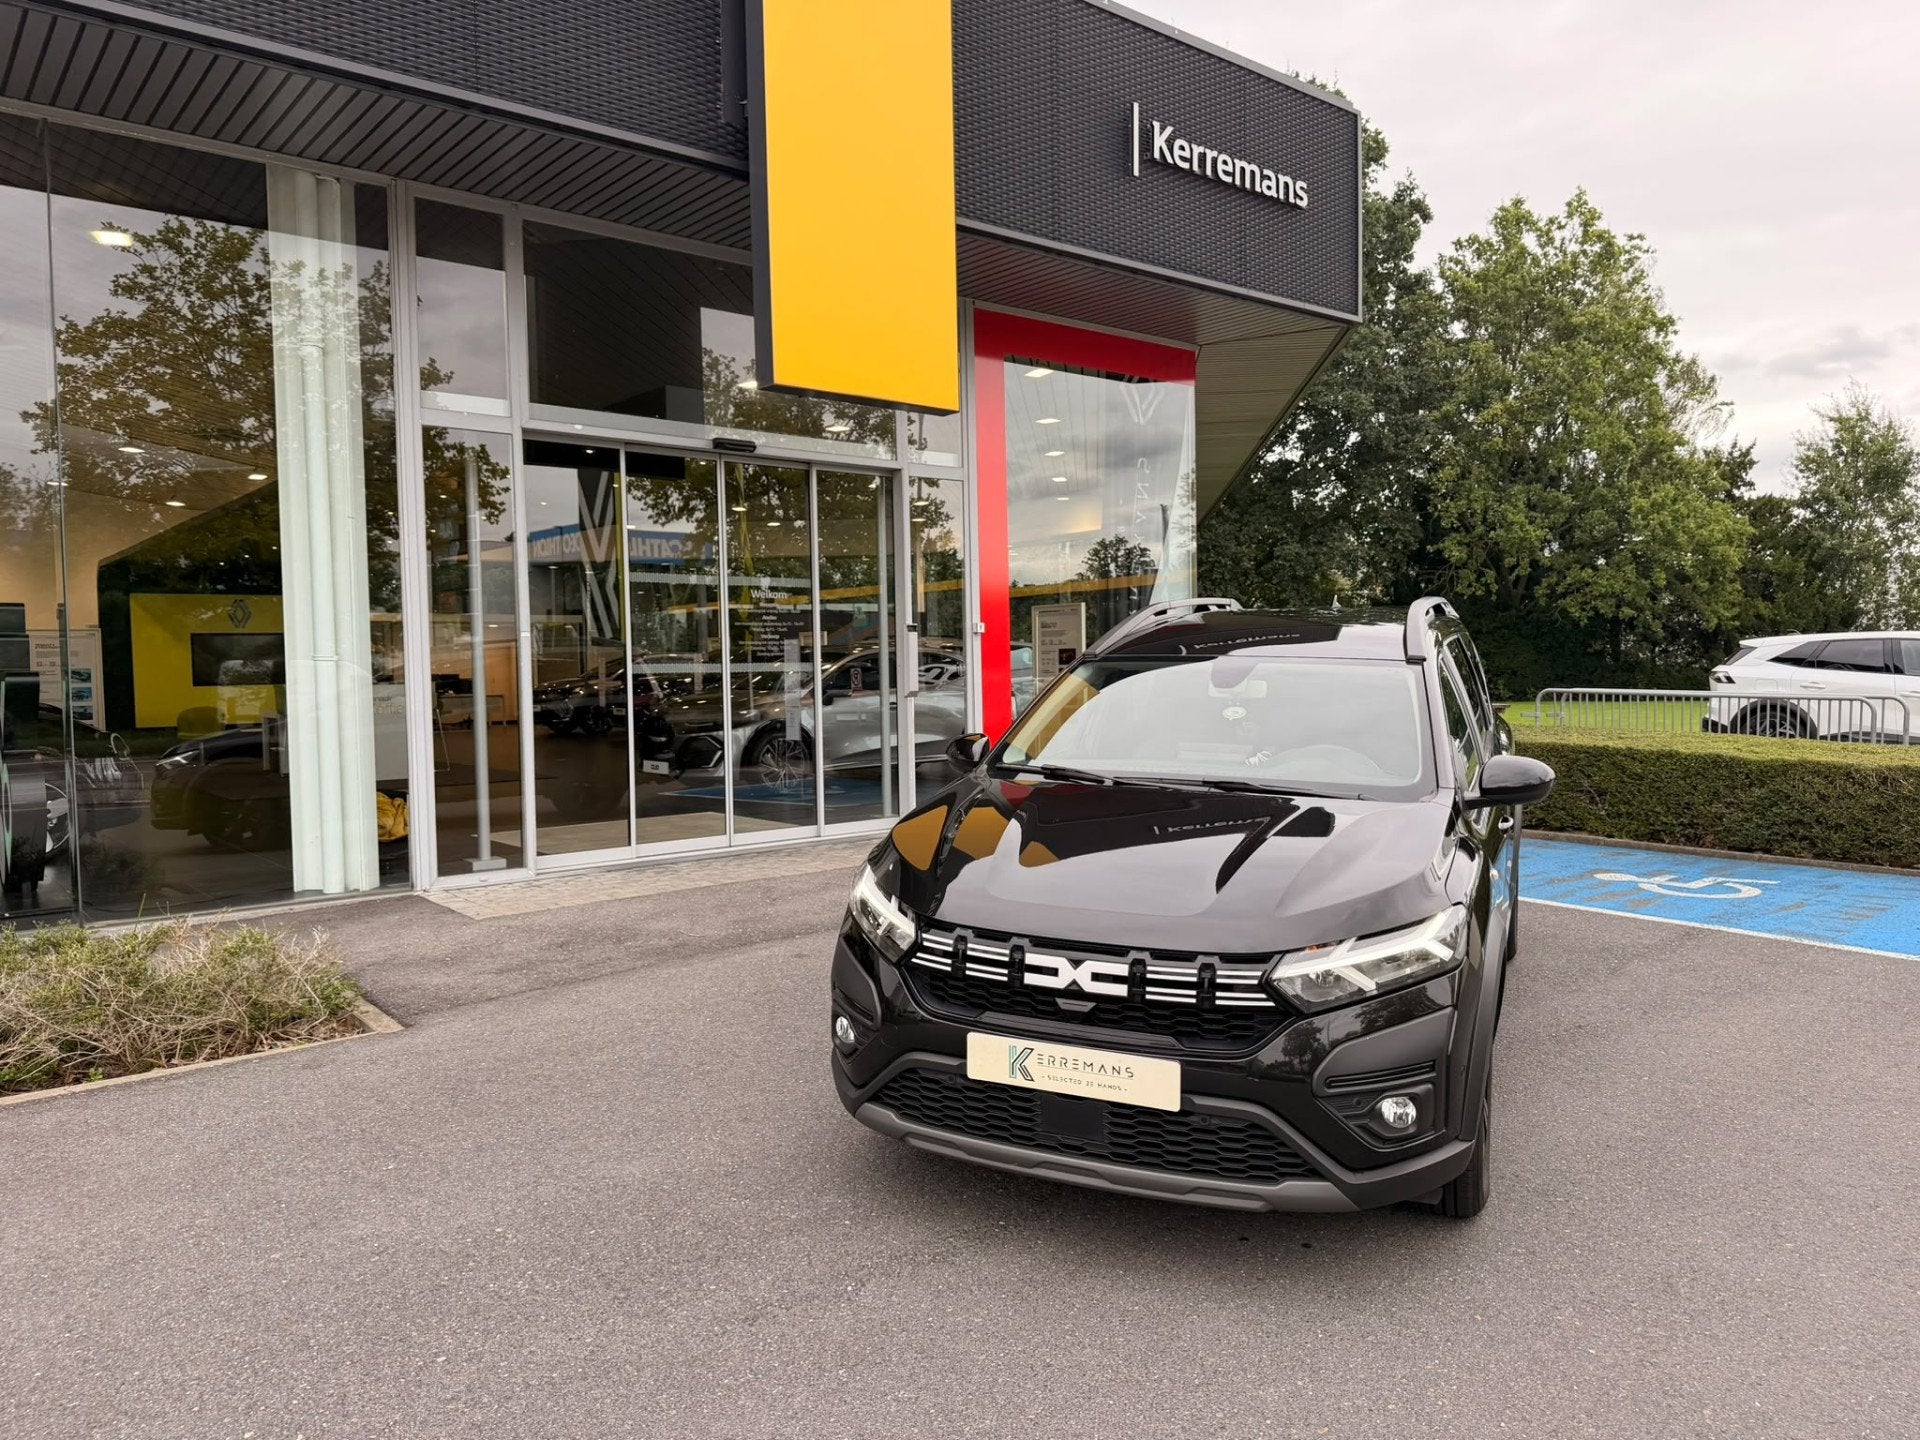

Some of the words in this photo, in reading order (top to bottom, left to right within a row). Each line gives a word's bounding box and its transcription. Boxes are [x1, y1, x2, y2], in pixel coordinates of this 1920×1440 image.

[1152, 120, 1309, 209] Kerremans
[750, 589, 788, 600] Welkom
[1008, 1044, 1134, 1082] KERREMANS
[1047, 1074, 1082, 1085] SELECTED
[1097, 1082, 1122, 1092] HANDS
